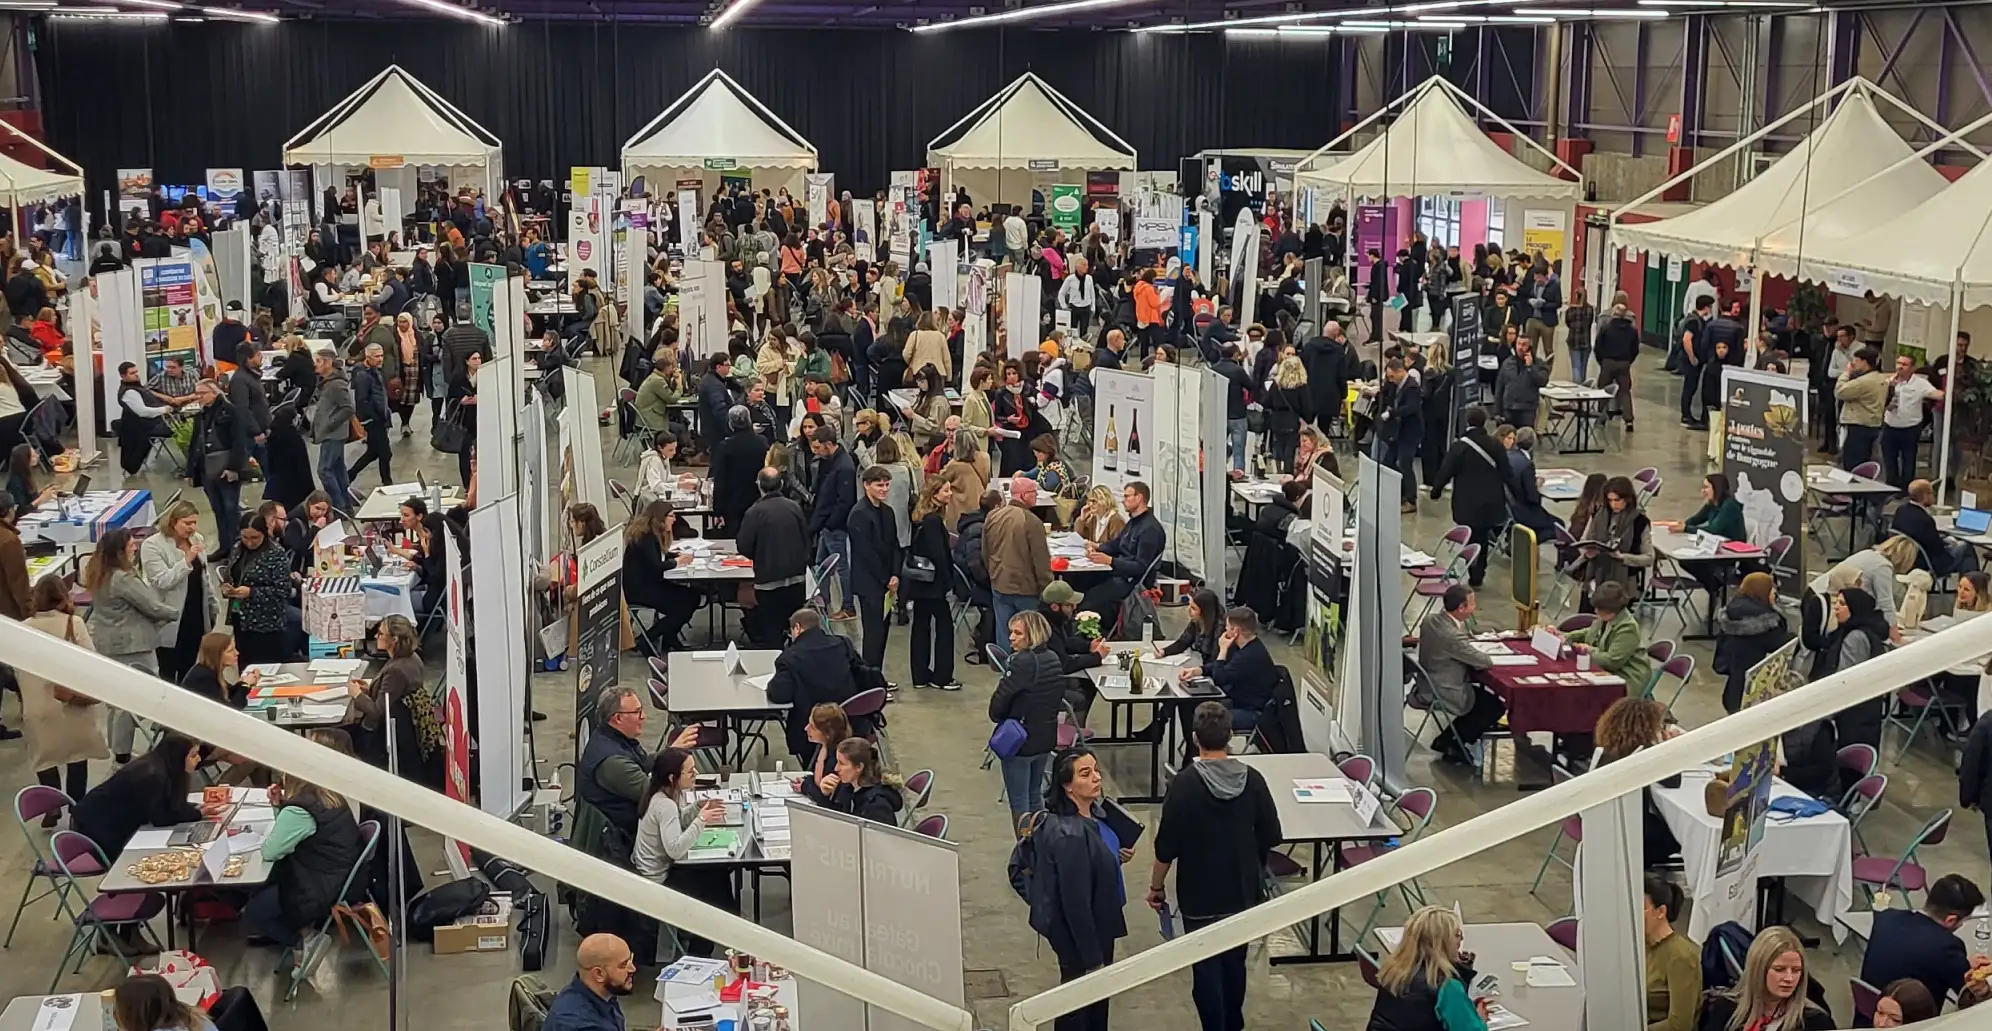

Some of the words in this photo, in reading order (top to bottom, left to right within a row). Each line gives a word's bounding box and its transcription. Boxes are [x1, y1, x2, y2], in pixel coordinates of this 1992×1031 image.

[1220, 169, 1262, 197] bskill
[1138, 222, 1175, 232] MPSA
[590, 547, 618, 572] Constellium
